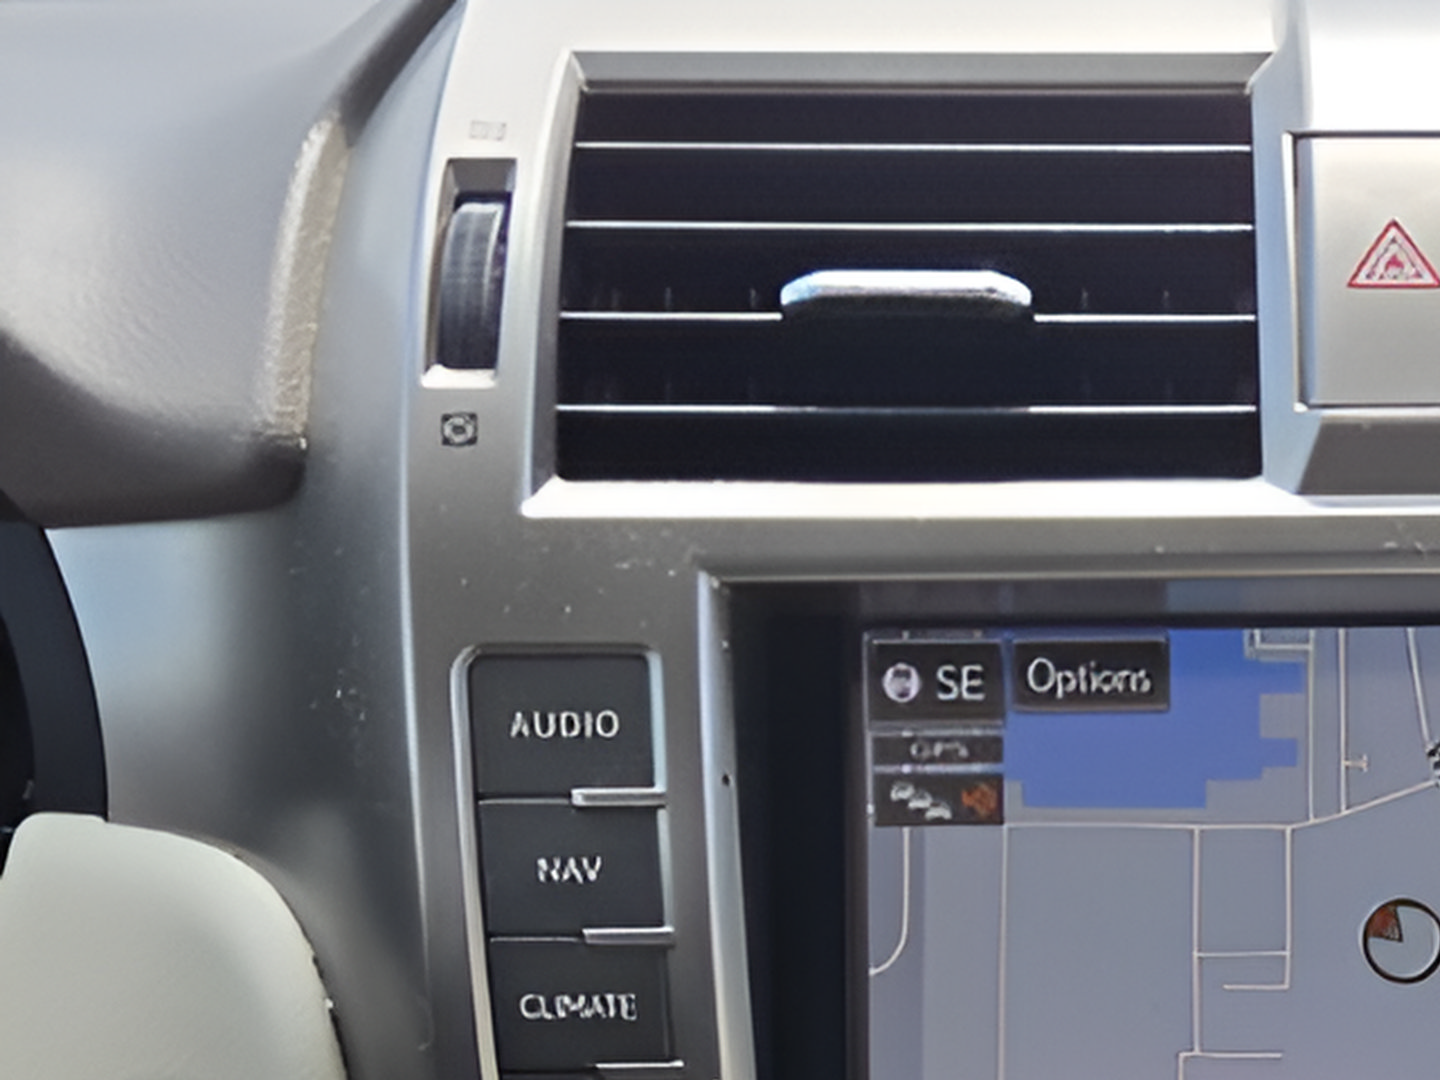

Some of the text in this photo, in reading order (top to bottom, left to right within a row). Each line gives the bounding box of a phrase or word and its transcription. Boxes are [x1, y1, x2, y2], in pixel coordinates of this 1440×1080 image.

[937, 664, 985, 700] SE
[1027, 658, 1152, 698] Options
[510, 710, 620, 739] AUDIO
[536, 856, 602, 884] NAV
[520, 993, 637, 1021] CLIMATE
